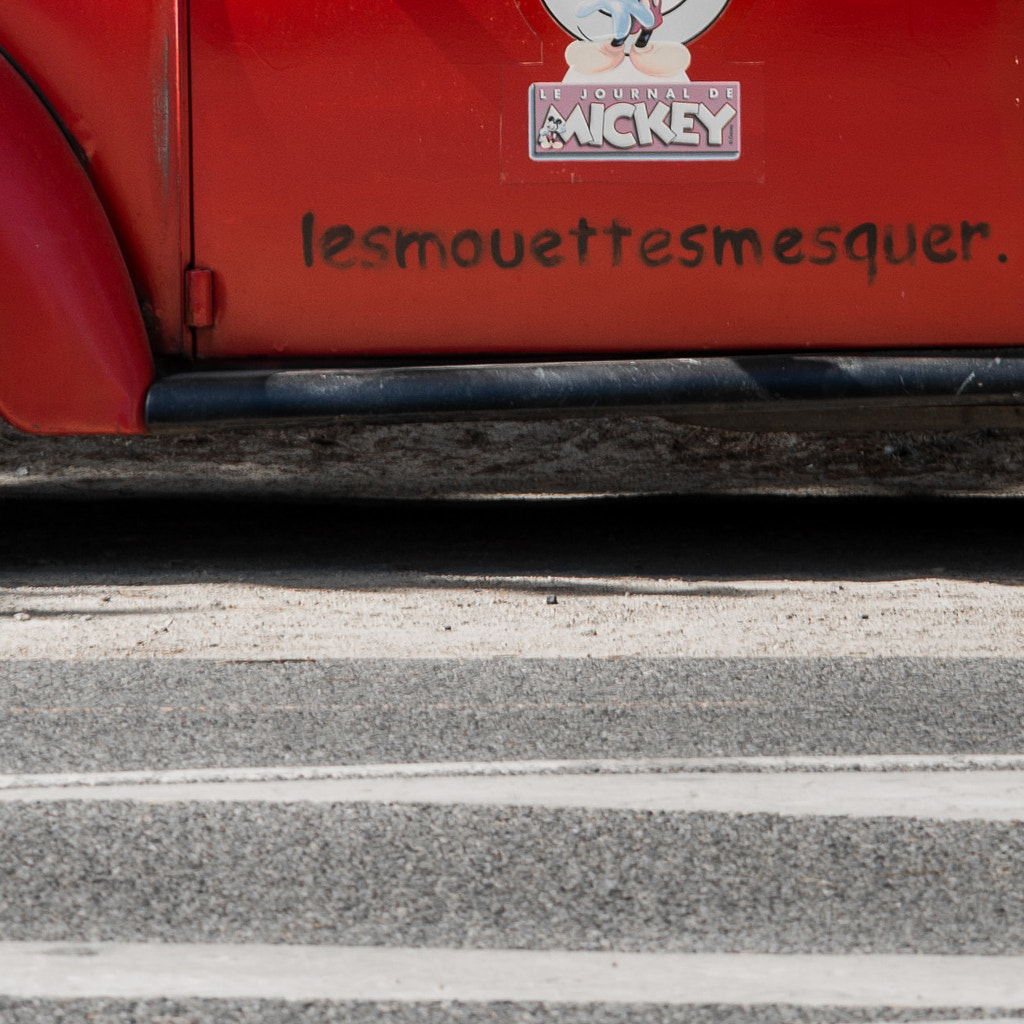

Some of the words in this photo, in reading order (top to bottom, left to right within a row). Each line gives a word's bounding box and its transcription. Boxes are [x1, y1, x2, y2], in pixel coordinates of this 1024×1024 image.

[539, 87, 562, 101] LE
[580, 87, 690, 101] JOURNAL
[709, 87, 734, 100] DE
[539, 100, 738, 149] MICKEY
